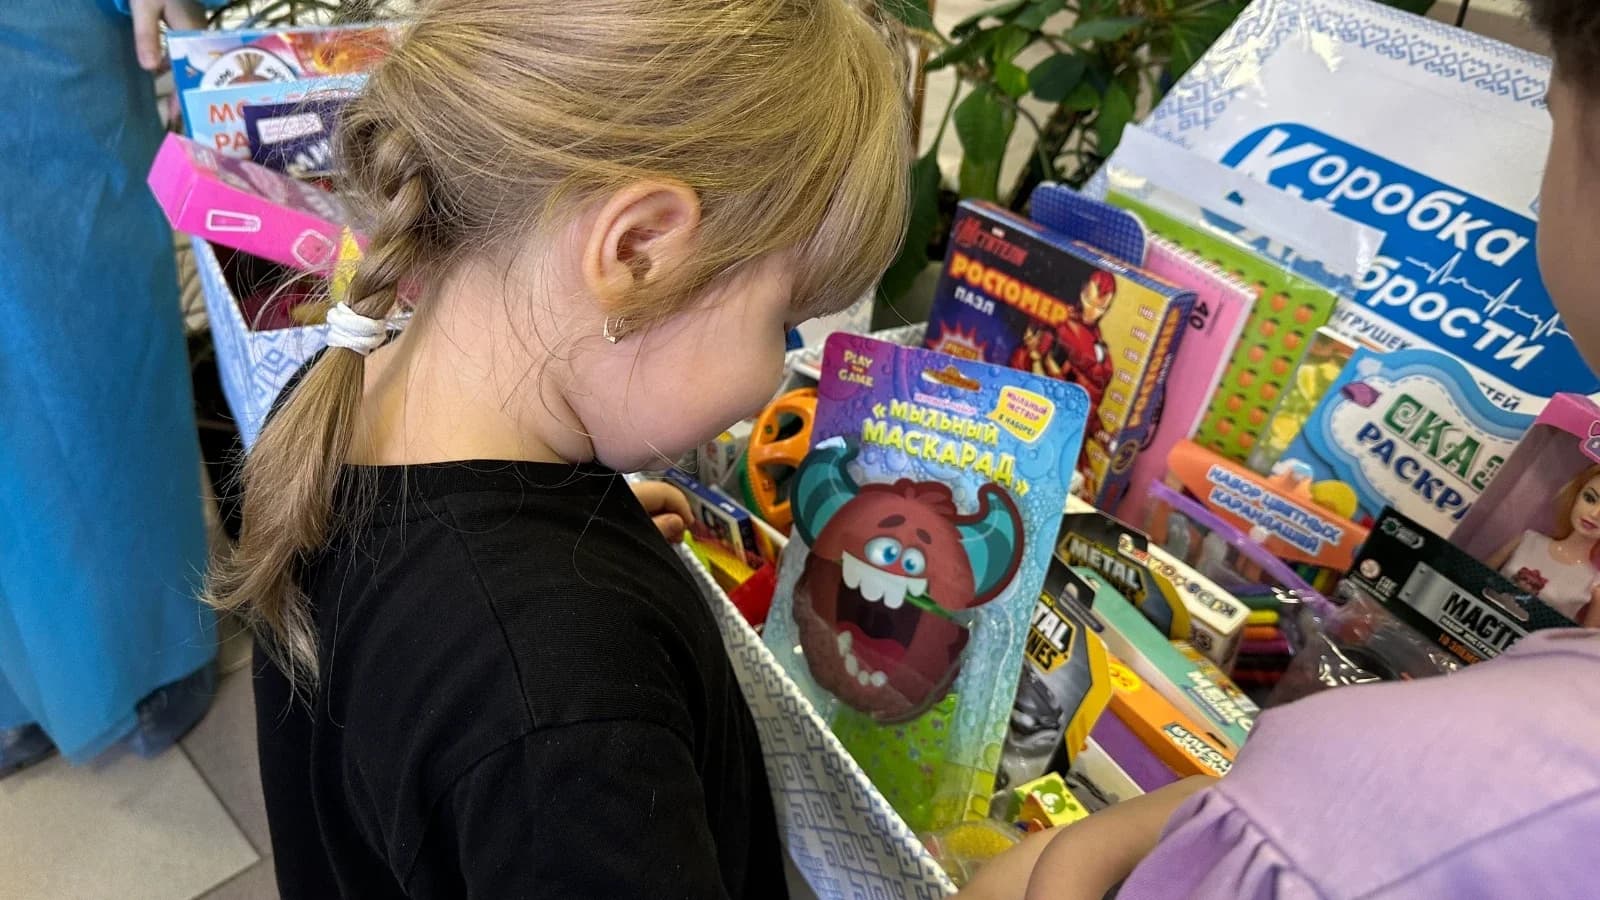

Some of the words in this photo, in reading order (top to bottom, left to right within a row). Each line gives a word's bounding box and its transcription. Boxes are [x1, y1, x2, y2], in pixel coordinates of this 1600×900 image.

[1231, 128, 1529, 266] Коробка
[949, 251, 1069, 326] РОСТОМЕР
[954, 286, 995, 315] ПАЗЛ
[1188, 302, 1210, 331] 40
[1359, 255, 1545, 371] брости
[838, 369, 875, 387] GAME
[843, 350, 873, 368] PLAY
[862, 418, 1030, 496] МАСКАРАД»
[1356, 421, 1472, 520] РАСКР
[1207, 465, 1263, 498] НАБОР
[1262, 493, 1342, 542] ЦВЕТНЫХ
[1210, 487, 1320, 552] КАРАНДАШЕЙ
[1068, 537, 1141, 590] METAL
